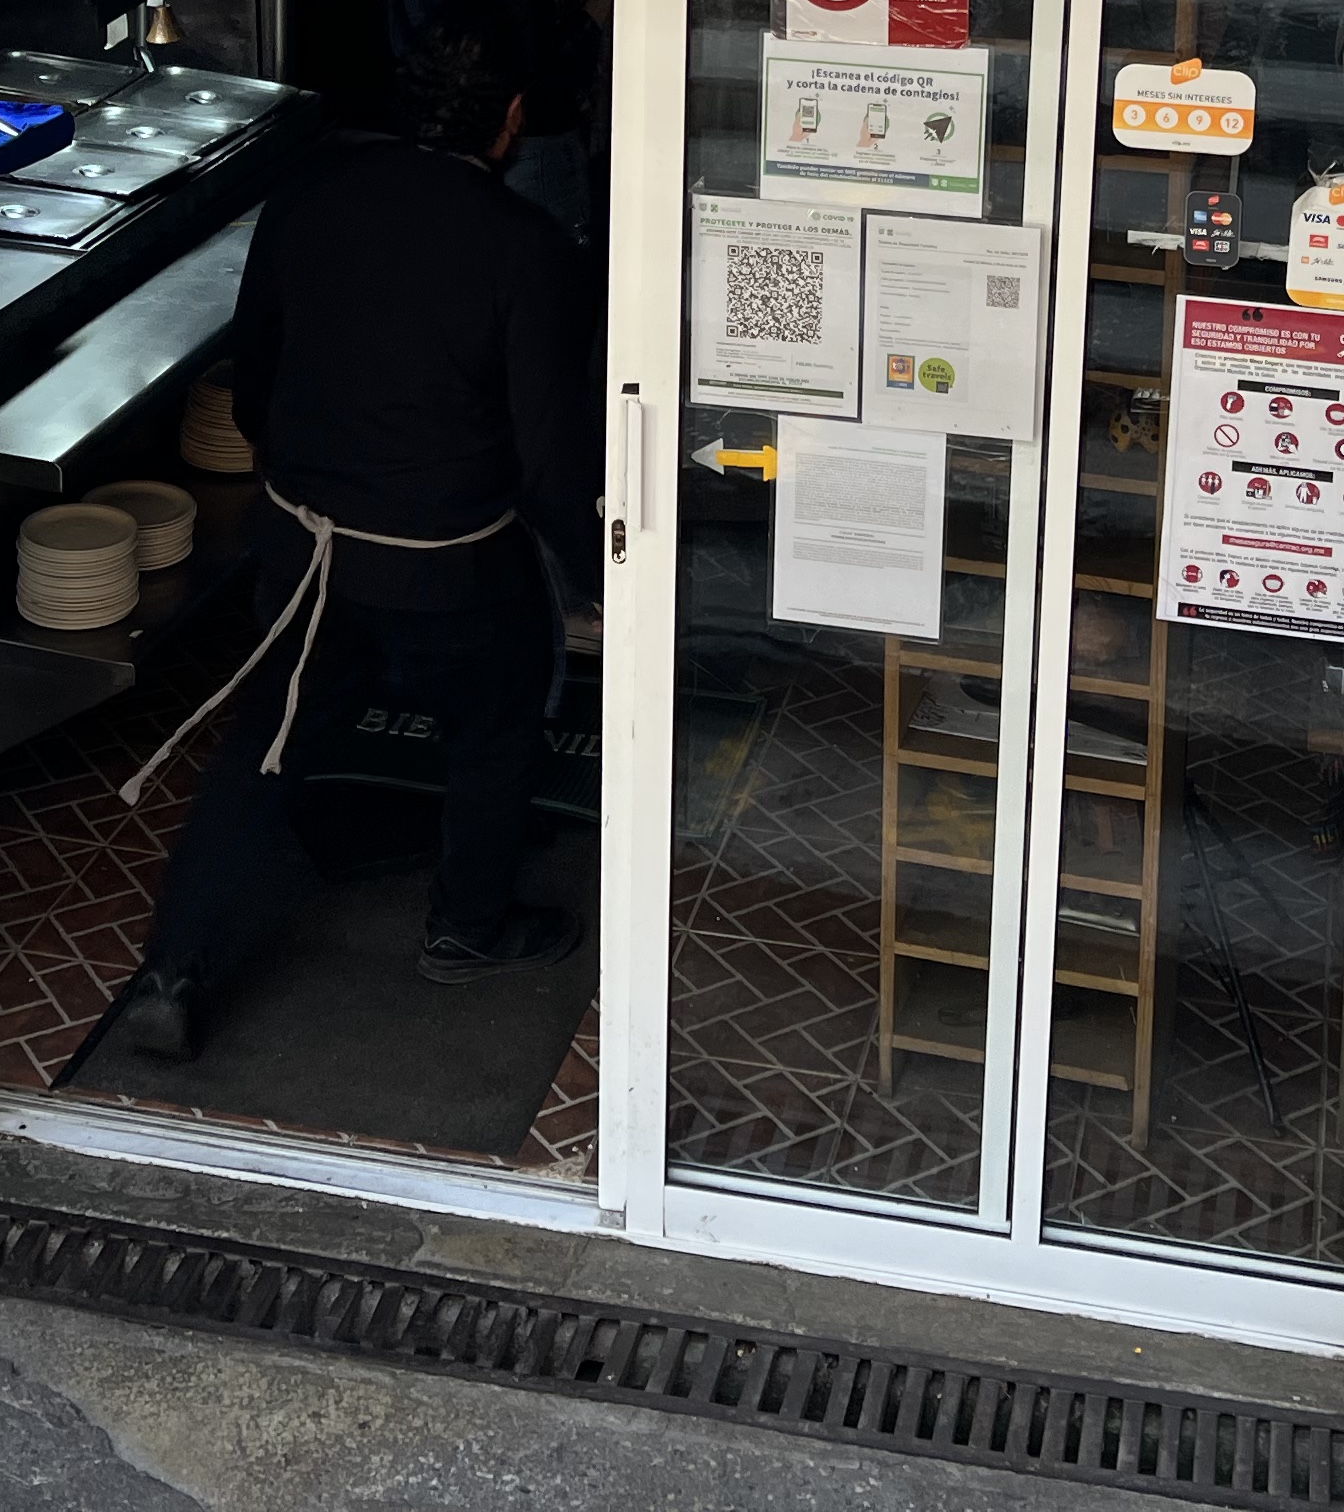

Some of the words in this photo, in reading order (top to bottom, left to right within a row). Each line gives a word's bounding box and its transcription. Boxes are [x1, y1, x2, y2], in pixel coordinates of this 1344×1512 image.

[811, 68, 861, 81] ¡Escanea
[864, 71, 874, 82] el
[877, 72, 914, 86] código
[916, 76, 933, 88] QR
[1172, 66, 1199, 79] clip
[787, 79, 793, 89] y
[796, 80, 825, 90] corta
[828, 80, 838, 91] la
[840, 82, 881, 95] cadena
[883, 85, 897, 96] de
[900, 88, 960, 101] contagios!
[1137, 90, 1166, 100] MESES
[1167, 92, 1182, 101] SIN
[1185, 94, 1232, 104] INTERESES
[1131, 109, 1138, 120] 3
[1162, 113, 1170, 123] 6
[1195, 115, 1203, 125] 9
[1225, 118, 1239, 129] 12
[822, 214, 846, 222] COVID
[1303, 212, 1331, 225] VISA
[756, 222, 792, 231] PROTEGE
[803, 225, 819, 234] LOS
[1189, 228, 1207, 236] VISA
[1192, 321, 1226, 332] NUESTRO
[1228, 324, 1279, 337] COMPROMISO
[1281, 329, 1291, 338] ES
[1292, 331, 1308, 340] CON
[1310, 333, 1320, 341] TU
[1191, 329, 1235, 342] SEGURIDAD
[1236, 334, 1241, 342] Y
[1242, 334, 1297, 348] TRANQUILIDAD
[1299, 340, 1315, 350] POR
[1191, 337, 1206, 346] ESO
[1207, 339, 1242, 350] ESTAMOS
[1244, 344, 1286, 354] CUBIERTOS
[927, 364, 945, 372] Safe
[922, 371, 951, 381] travels
